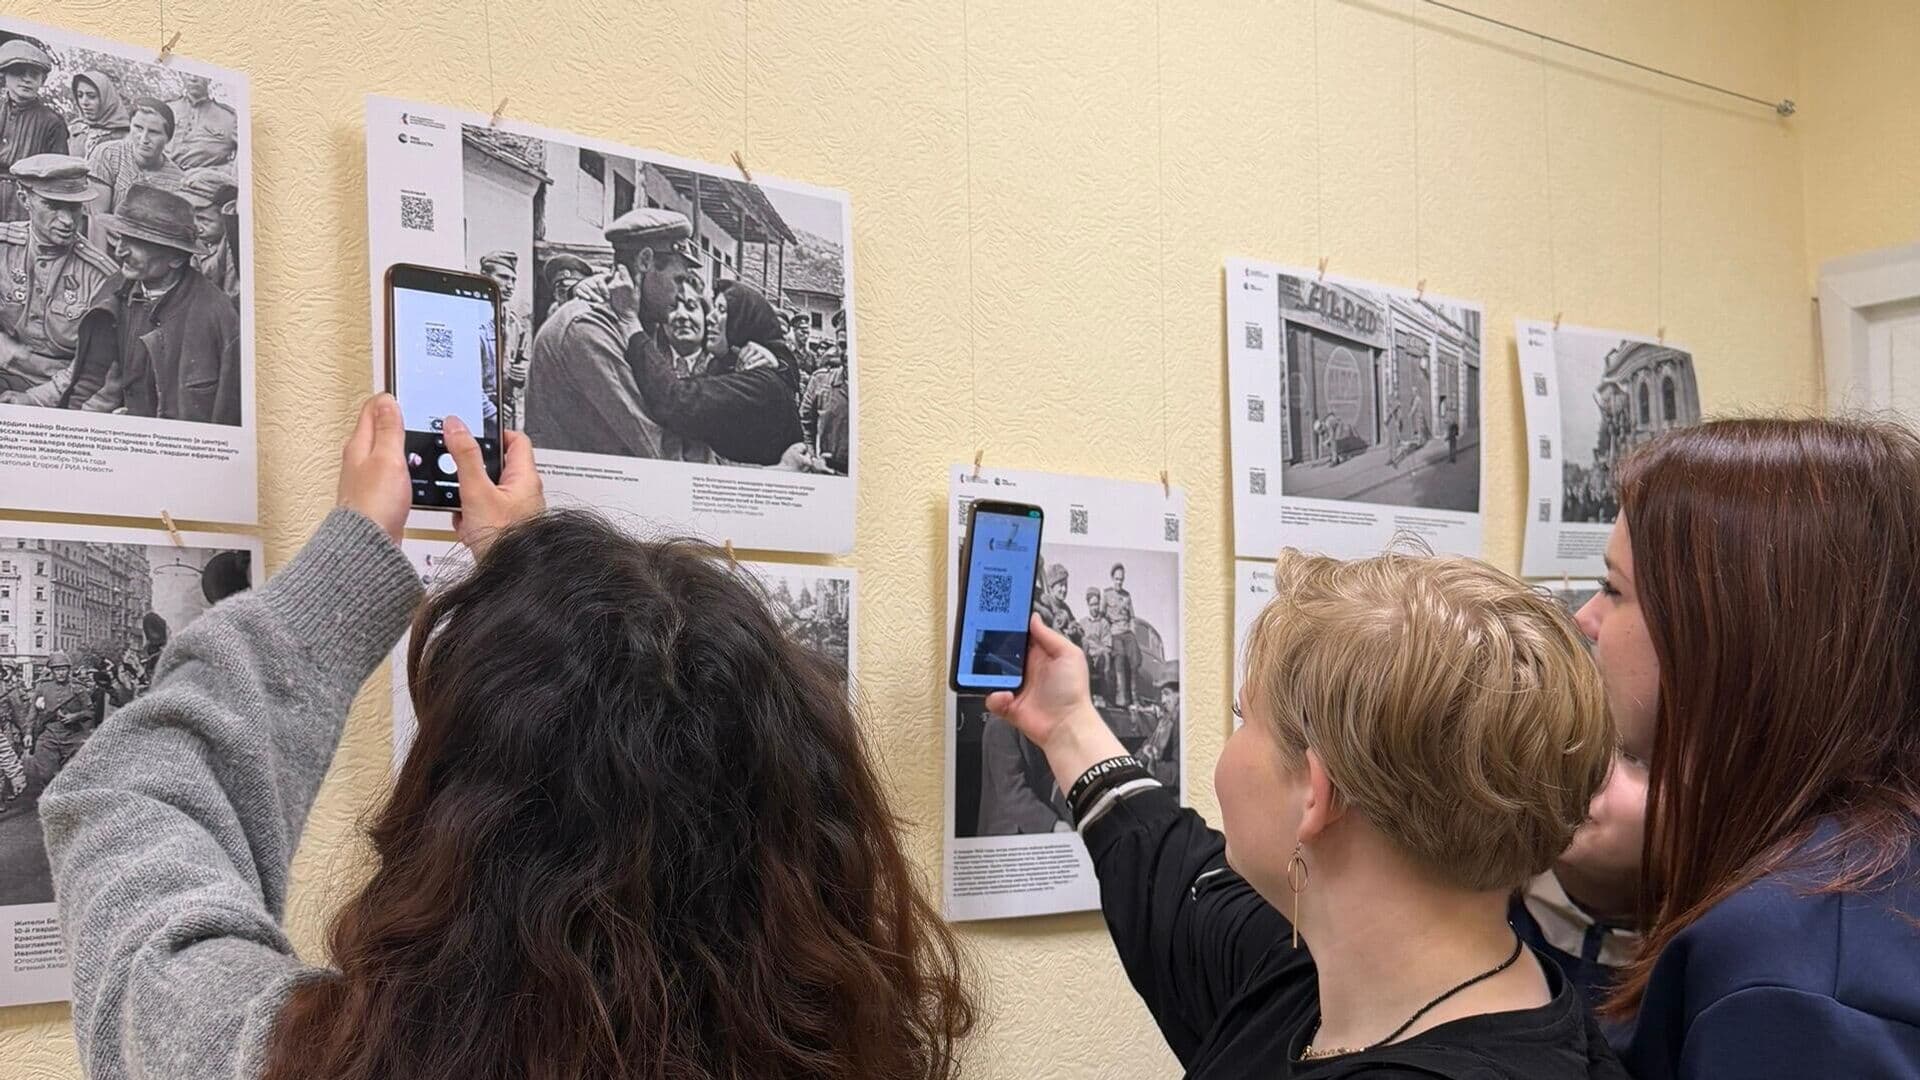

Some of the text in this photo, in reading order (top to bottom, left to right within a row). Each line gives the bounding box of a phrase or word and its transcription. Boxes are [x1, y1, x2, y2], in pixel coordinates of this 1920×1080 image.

[56, 424, 89, 433] Василий
[90, 428, 151, 439] Константинович
[85, 435, 112, 443] города
[96, 444, 128, 452] Красной
